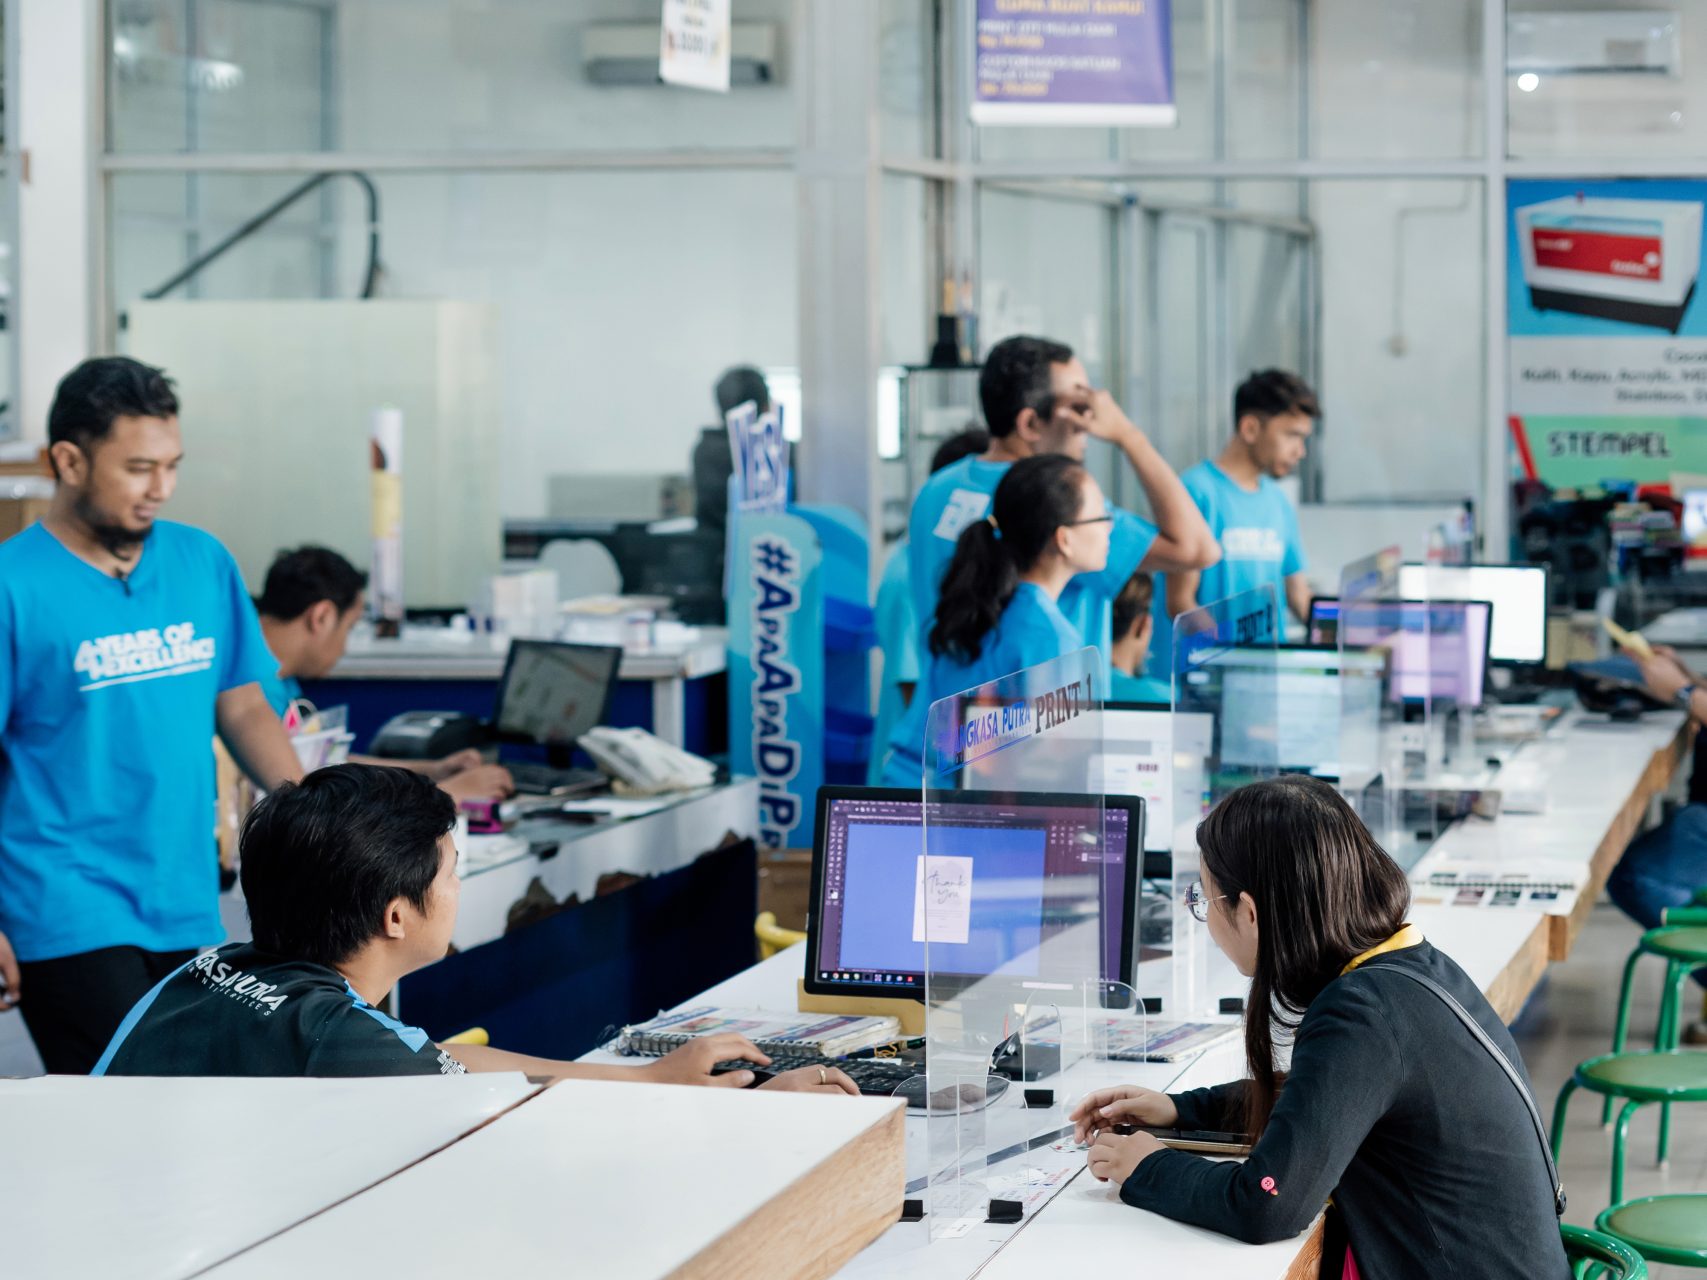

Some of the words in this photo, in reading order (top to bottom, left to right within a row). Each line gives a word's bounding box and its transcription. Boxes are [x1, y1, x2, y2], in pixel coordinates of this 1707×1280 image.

[1548, 432, 1671, 458] STEMPEL
[163, 620, 196, 645] OF
[1002, 701, 1031, 735] PUTRA
[1035, 681, 1081, 734] PRINT
[1085, 673, 1093, 712] 1
